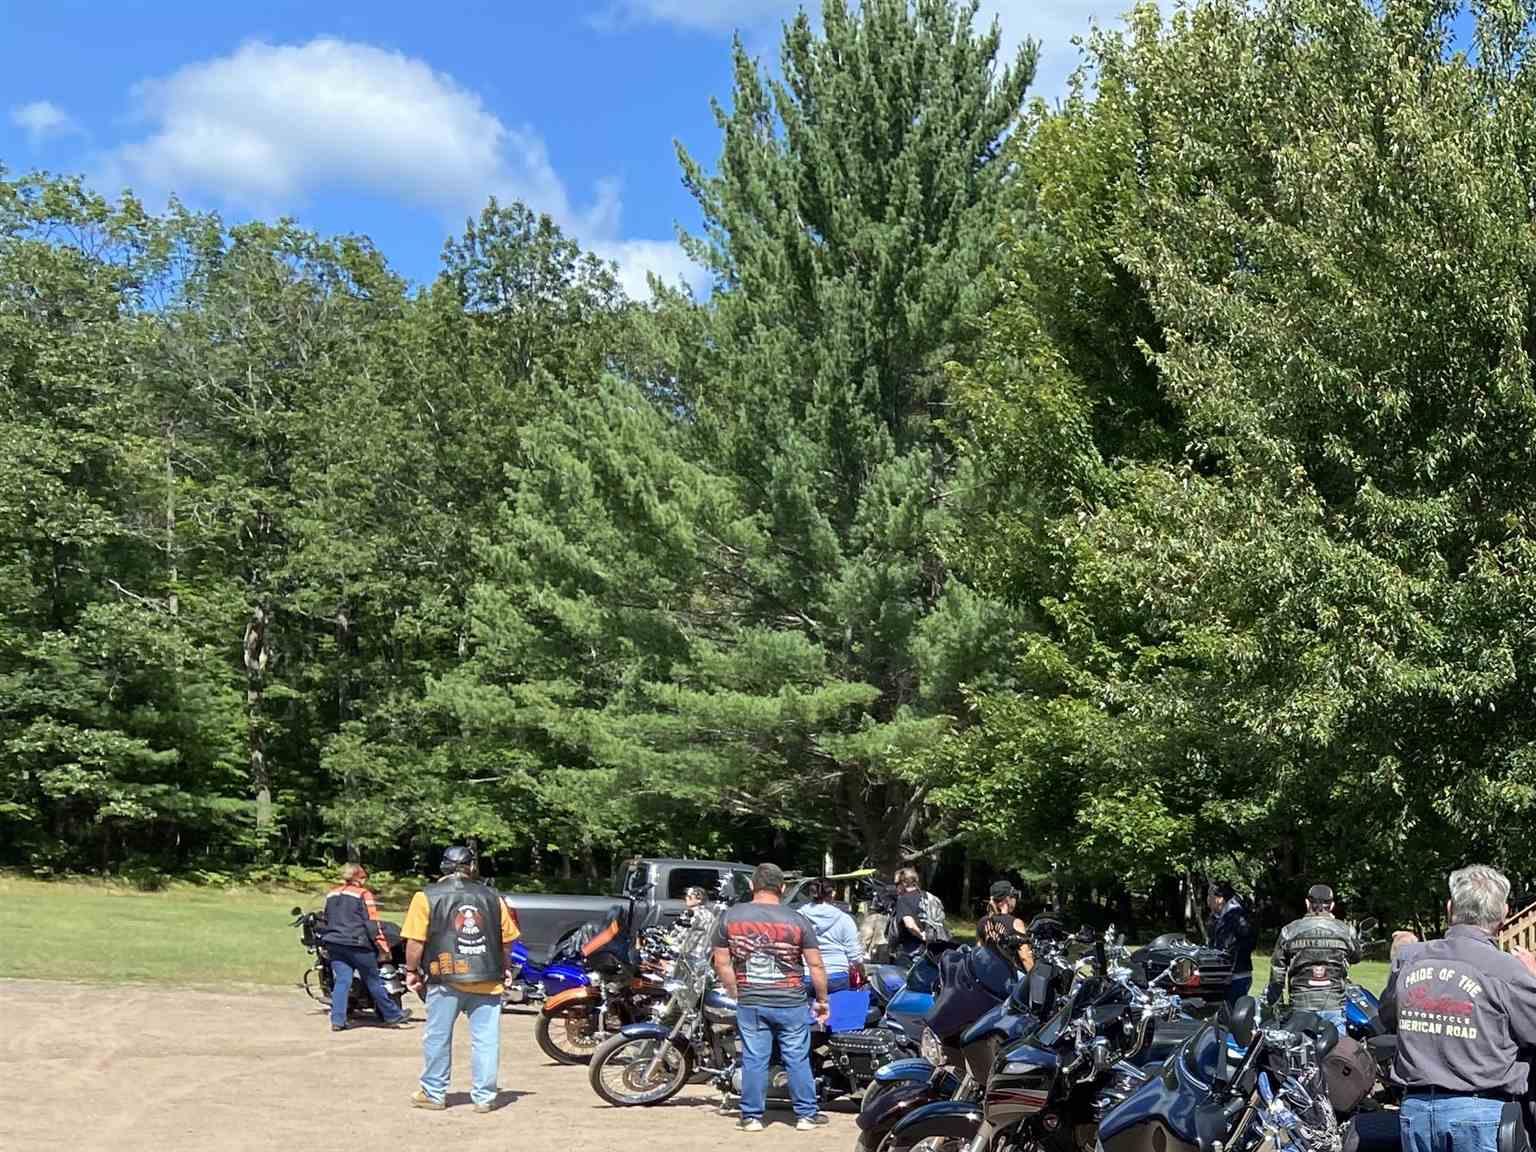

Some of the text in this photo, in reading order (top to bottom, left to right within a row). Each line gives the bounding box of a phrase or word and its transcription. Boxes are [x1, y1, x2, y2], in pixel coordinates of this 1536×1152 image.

[1405, 967, 1483, 998] PRIDE OF THE
[1446, 1024, 1478, 1039] ROAD
